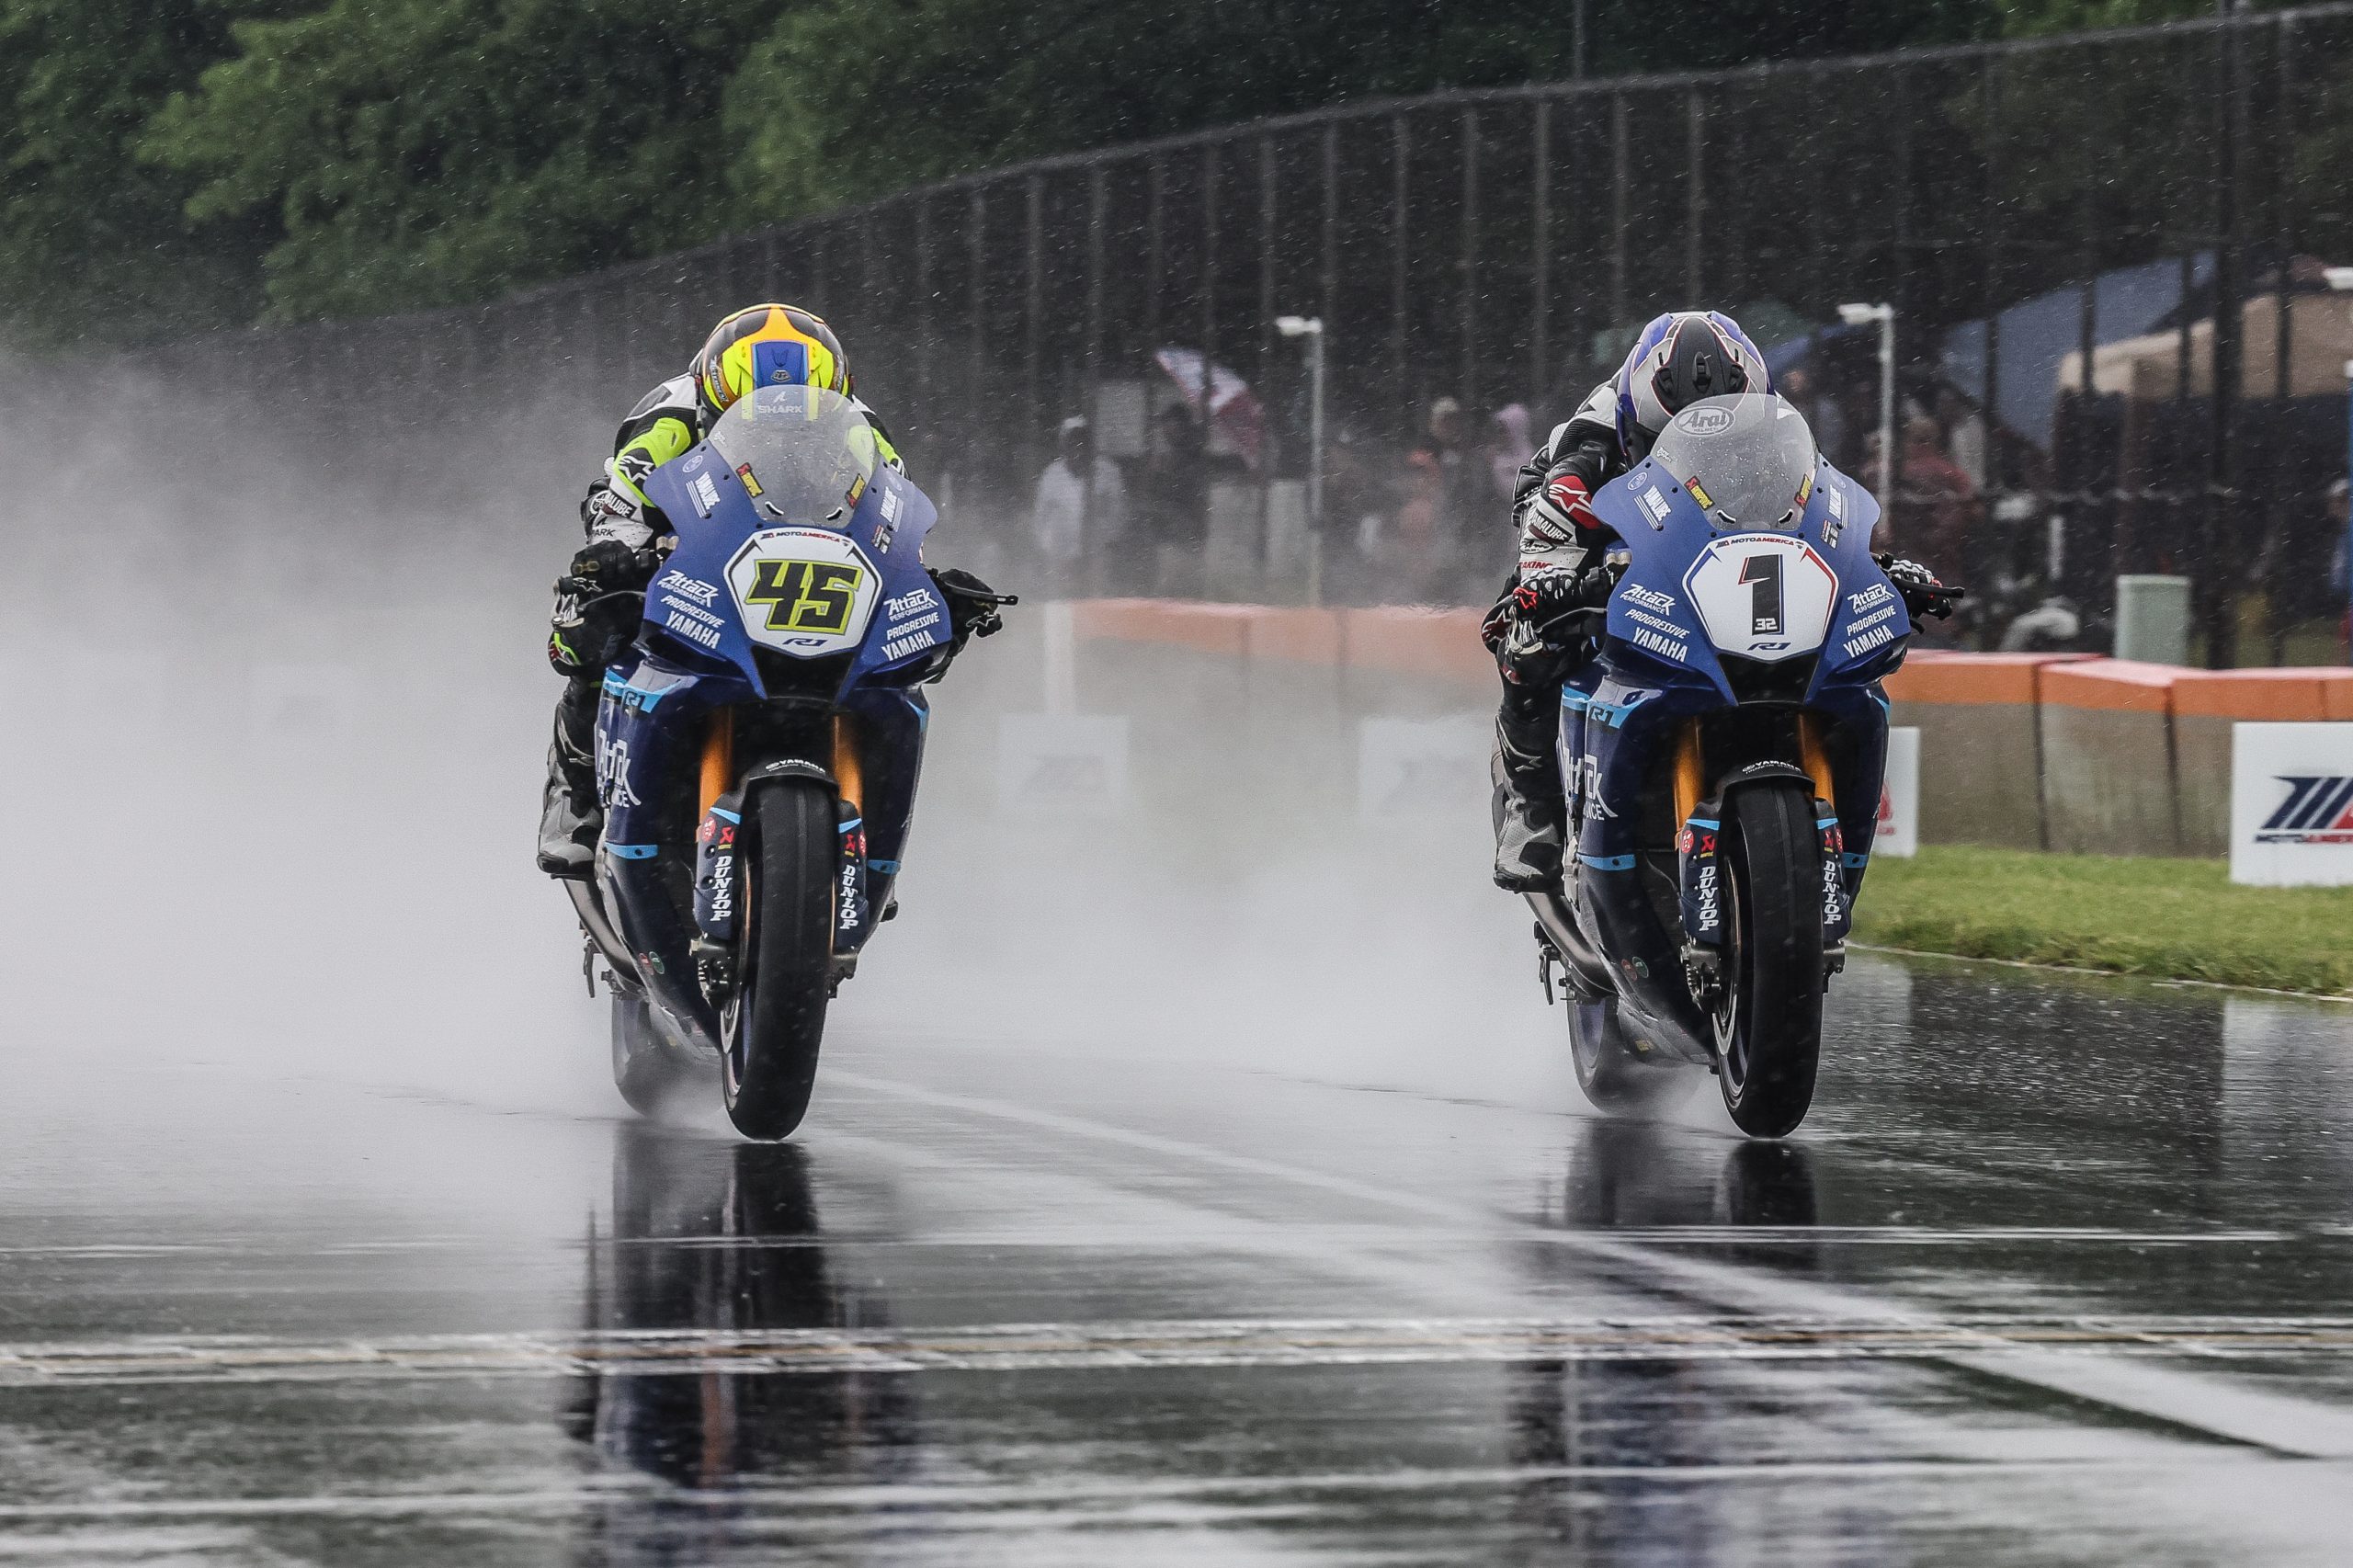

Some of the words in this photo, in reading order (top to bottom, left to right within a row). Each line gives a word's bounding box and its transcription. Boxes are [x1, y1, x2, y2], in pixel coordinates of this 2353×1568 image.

[756, 404, 803, 414] SHARK
[1679, 411, 1727, 428] Arai
[776, 531, 840, 543] MOTOAMERICA
[1731, 537, 1794, 546] MOTOAMERICA
[657, 580, 707, 607] PERFORMANCE
[662, 569, 719, 608] Attack
[745, 559, 864, 636] 45
[883, 588, 938, 617] Attack
[1620, 593, 1665, 615] PERFORMANCE
[1623, 583, 1677, 617] Attack
[1738, 554, 1784, 636] 1
[1847, 583, 1895, 610] Attack
[660, 595, 725, 629] PROGRESSIVE
[889, 602, 935, 622] PERFORMANCE
[1853, 595, 1893, 615] PERFORMANCE
[665, 610, 721, 649] YAMAHA
[886, 611, 940, 641] PROGRESSIVE
[1624, 608, 1690, 639] PROGRESSIVE
[1755, 618, 1778, 631] 32
[1847, 605, 1897, 637] PROGRESSIVE
[881, 630, 936, 661] YAMAHA
[1632, 627, 1688, 663] YAMAHA
[1843, 624, 1895, 658] YAMAHA
[710, 856, 733, 922] DUNLOP
[839, 864, 858, 930] DUNLOP
[1699, 866, 1719, 932] DUNLOP
[1823, 859, 1842, 925] DUNLOP
